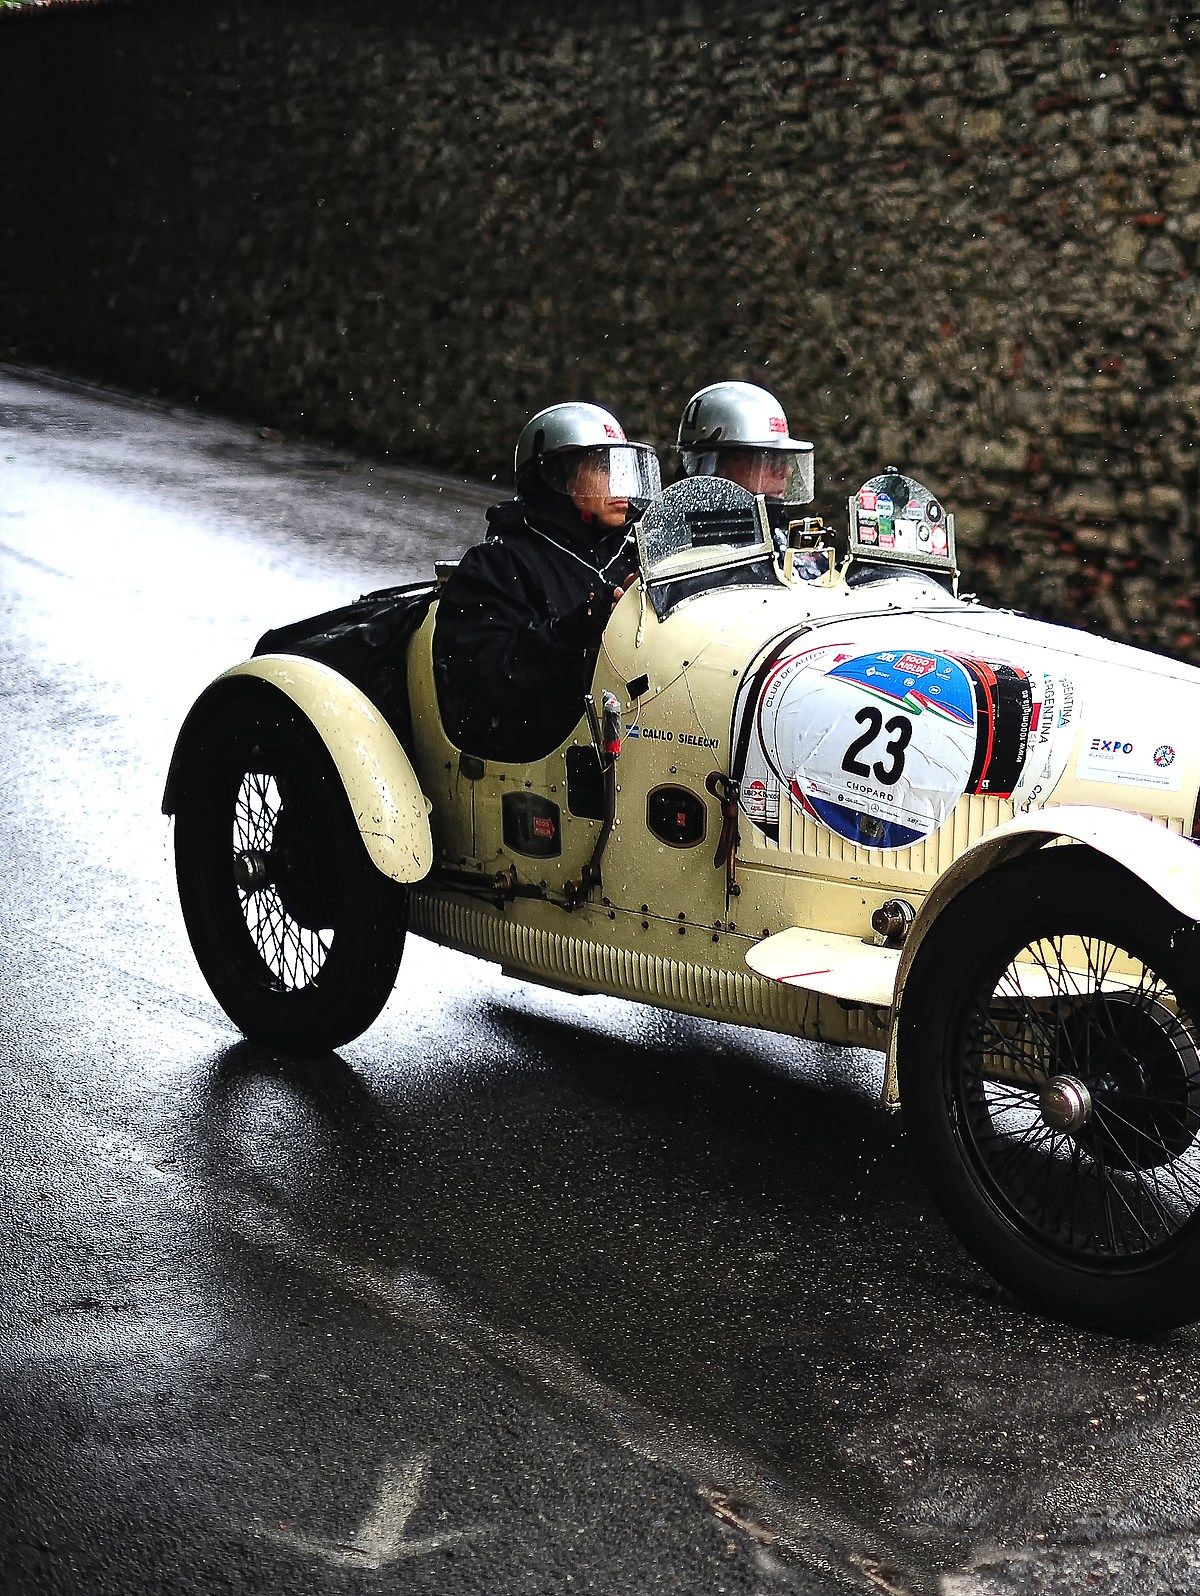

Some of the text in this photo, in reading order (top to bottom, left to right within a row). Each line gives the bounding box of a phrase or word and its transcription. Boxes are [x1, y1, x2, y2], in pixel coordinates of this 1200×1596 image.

[766, 680, 782, 707] CLUB
[643, 728, 719, 749] CALILO SIELECKI
[841, 706, 912, 785] 23
[1091, 739, 1133, 754] EXPO
[846, 780, 894, 802] CHOPARD
